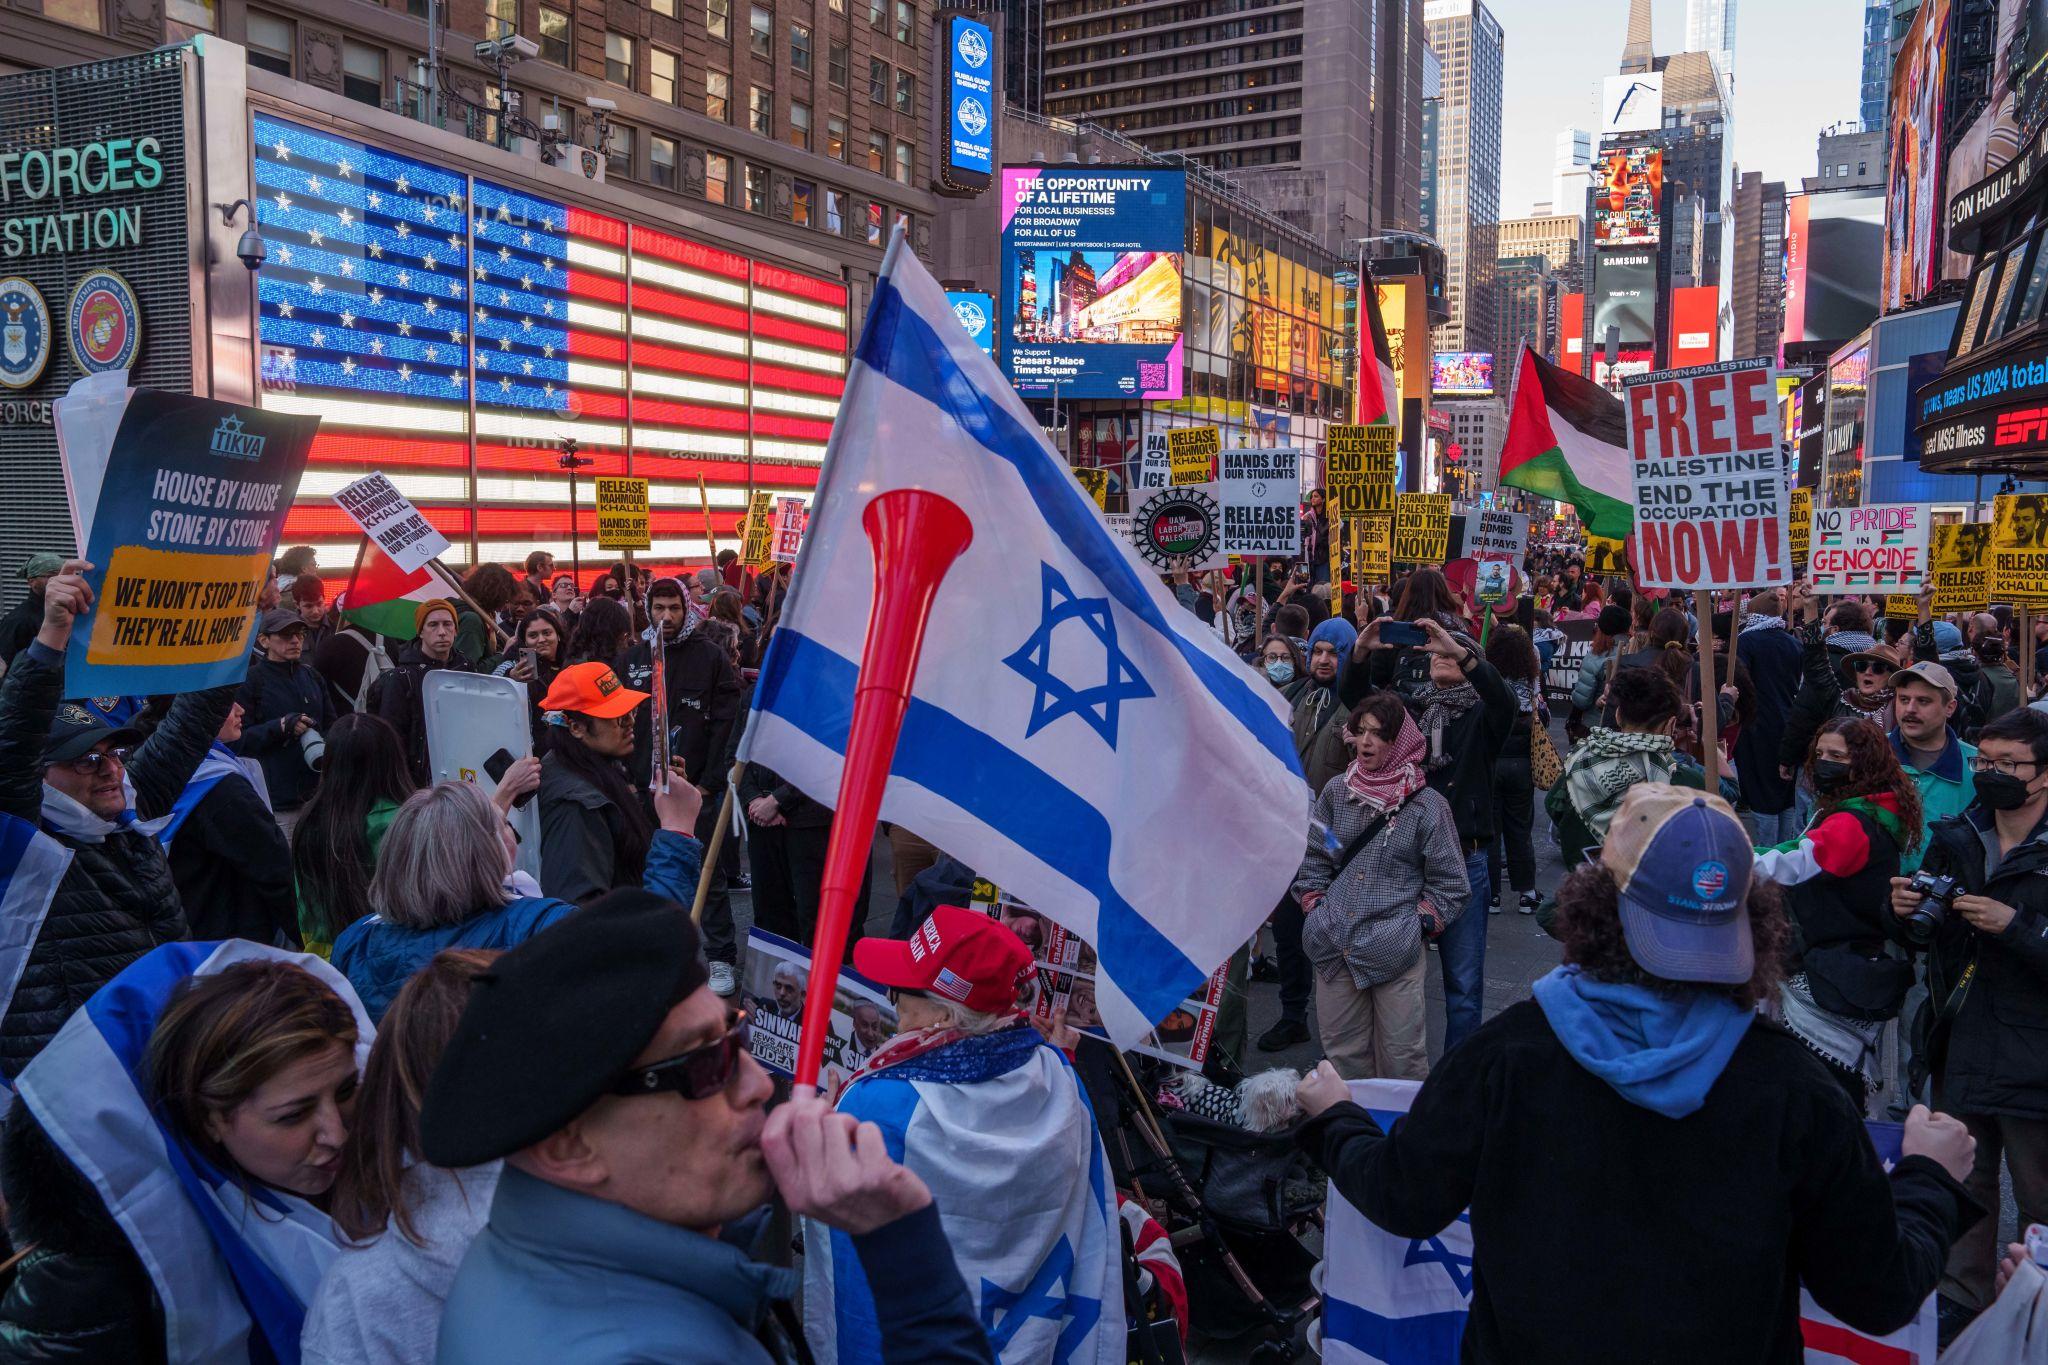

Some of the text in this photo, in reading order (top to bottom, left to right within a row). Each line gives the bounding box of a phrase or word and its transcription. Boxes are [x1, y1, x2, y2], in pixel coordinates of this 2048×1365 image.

[954, 71, 974, 82] BUBBA
[954, 140, 974, 150] BUBBA
[1, 137, 163, 200] FORCES
[1015, 178, 1151, 190] THE OPPORTUNITY
[1015, 192, 1116, 204] OF A LIFETIME
[1957, 172, 2012, 222] ON HULU!
[1015, 206, 1032, 214] FOR
[4, 206, 141, 257] STATION
[1604, 256, 1648, 266] SAMSUNG
[1013, 357, 1085, 365] Caesars Palace
[1014, 366, 1077, 376] Times Square
[1924, 394, 1942, 420] grows,
[1944, 386, 1966, 408] nears
[1967, 374, 1981, 400] US
[1982, 366, 2008, 397] 2024
[1630, 369, 1773, 460] FREE
[1171, 429, 1215, 446] RELEASE
[1330, 426, 1394, 439] STAND WITH
[1827, 429, 1837, 455] OLD
[1837, 421, 1854, 453] NAVY
[1937, 426, 1954, 453] MSG
[1956, 424, 1985, 448] illness
[216, 431, 261, 455] TIKVA
[1172, 443, 1218, 457] MAHMOUD
[1330, 440, 1394, 453] PALESTINE!
[1225, 454, 1296, 468] HANDS OFF
[1329, 454, 1393, 471] END THE
[1636, 452, 1775, 478] PALESTINE
[1144, 472, 1165, 488] ICE
[1174, 470, 1203, 483] HANDS
[1225, 469, 1295, 479] OUR STUDENTS
[1328, 472, 1392, 484] OCCUPATION
[152, 468, 282, 512] HOUSE BY HOUSE
[337, 475, 391, 510] RELEASE
[600, 481, 644, 494] RELEASE
[1638, 478, 1775, 504] END THE
[600, 494, 645, 504] MAHMOUD
[1329, 485, 1391, 510] NOW!
[1400, 494, 1449, 504] STAND WITH
[350, 490, 400, 521] MAHMOUD
[1399, 504, 1449, 515] PALESTINE!
[1640, 502, 1776, 520] OCCUPATION
[362, 502, 409, 530] KHALIL
[752, 514, 766, 527] THE
[1169, 516, 1186, 524] UAW
[1225, 506, 1295, 524] RELEASE
[1398, 514, 1422, 527] END
[1426, 515, 1448, 528] THE
[1482, 512, 1513, 524] ISRAEL
[1816, 507, 1916, 531] NO PRIDE
[147, 510, 270, 547] STONE BY STONE
[376, 514, 424, 547] HANDS OFF
[600, 518, 647, 529] HANDS OFF
[1480, 523, 1512, 535] BOMBS
[1161, 533, 1199, 542] PALESTINE
[1225, 525, 1294, 539] MAHMOUD
[1396, 529, 1446, 539] OCCUPATION
[388, 524, 432, 555] OUR STUDENTS
[1225, 540, 1295, 550] KHALIL
[1472, 536, 1517, 549] USA PAYS
[1396, 538, 1445, 558] NOW!
[1641, 516, 1781, 584] NOW!
[1374, 551, 1387, 562] THE
[1813, 547, 1918, 571] GENOCIDE
[1939, 571, 1986, 586] RELEASE
[114, 577, 260, 610] WE WON'T STOP TILL
[1890, 596, 1904, 604] OUR
[1938, 594, 1984, 603] KHALIL!
[113, 616, 246, 646] THEY'RE ALL HOME
[924, 914, 941, 954] MERICA
[1214, 960, 1229, 1006] KIDNAPPED
[753, 1031, 794, 1052] JEWS ARE
[825, 1035, 840, 1048] and
[1196, 1011, 1214, 1060] KIDNAPPED
[751, 1042, 792, 1070] JUDEA
[823, 1047, 834, 1058] all
